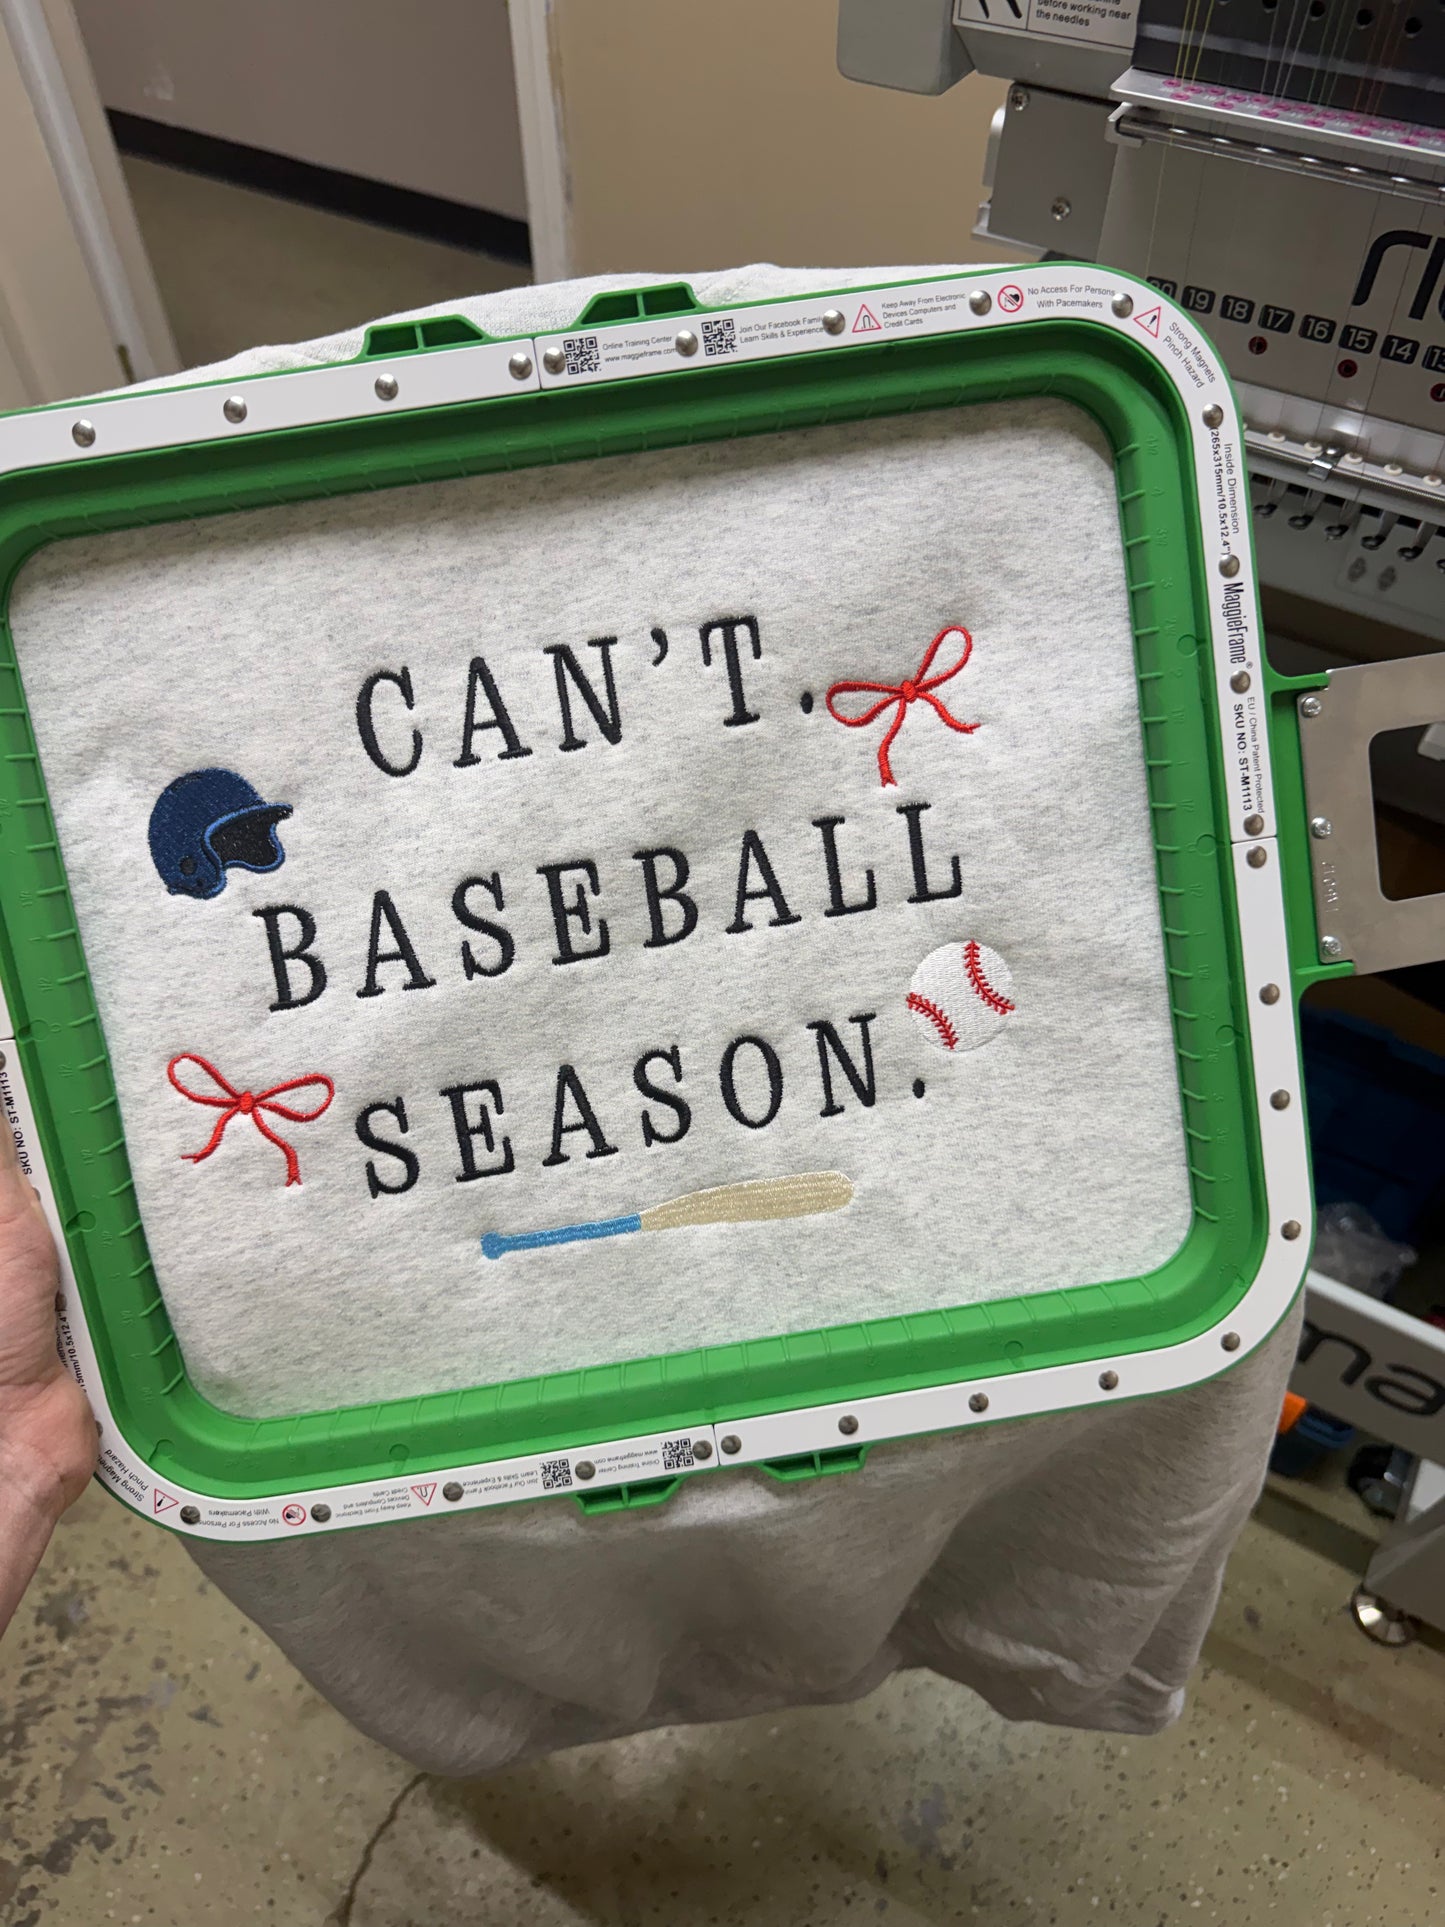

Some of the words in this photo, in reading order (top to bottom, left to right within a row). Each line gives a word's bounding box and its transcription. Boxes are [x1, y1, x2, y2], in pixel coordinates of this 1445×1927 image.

[1036, 9, 1051, 20] the
[1052, 13, 1090, 26] needles
[1070, 3, 1107, 18] working
[1108, 9, 1132, 20] near
[935, 293, 966, 302] Electronic
[1027, 287, 1039, 295] No
[1069, 284, 1083, 293] For
[1084, 285, 1116, 296] Persons
[1188, 290, 1210, 309] 19
[882, 310, 908, 319] Devices
[908, 306, 943, 315] Computers
[1036, 299, 1054, 308] With
[1055, 299, 1103, 308] Pacemakers
[1226, 299, 1249, 320] 18
[739, 326, 753, 334] Join
[753, 323, 767, 331] Our
[768, 319, 801, 329] Facebook
[883, 320, 903, 328] Credit
[904, 318, 924, 326] Cards
[1267, 308, 1290, 329] 17
[1306, 317, 1329, 340] 16
[602, 342, 623, 350] Online
[624, 339, 650, 347] Training
[650, 336, 672, 344] Center
[740, 335, 760, 343] Learn
[760, 331, 778, 341] Skills
[779, 330, 785, 338] &
[1348, 328, 1372, 350] 15
[1169, 321, 1193, 350] Strong
[1190, 346, 1216, 383] Magnets
[1389, 338, 1413, 360] 14
[1163, 335, 1183, 360] Pinch
[1181, 357, 1205, 389] Hazard
[1223, 443, 1235, 475] Inside
[1227, 478, 1240, 534] Dimension
[1247, 696, 1255, 710] EU
[1233, 703, 1245, 729] SKU
[1249, 718, 1257, 742] China
[1236, 732, 1247, 754] NO:
[1252, 744, 1261, 772] Patent
[1238, 757, 1253, 811] ST-M1113
[1254, 773, 1265, 813] Protected
[253, 803, 962, 1012] BASEBALL
[0, 1071, 20, 1124] ST-M1113
[355, 1013, 926, 1198] SEASON.
[13, 1127, 26, 1148] NO:
[18, 1151, 33, 1175] SKU
[104, 1449, 129, 1475] Hazard
[520, 1469, 538, 1477] Learn
[121, 1479, 145, 1502] Strong
[128, 1472, 149, 1491] Pinch
